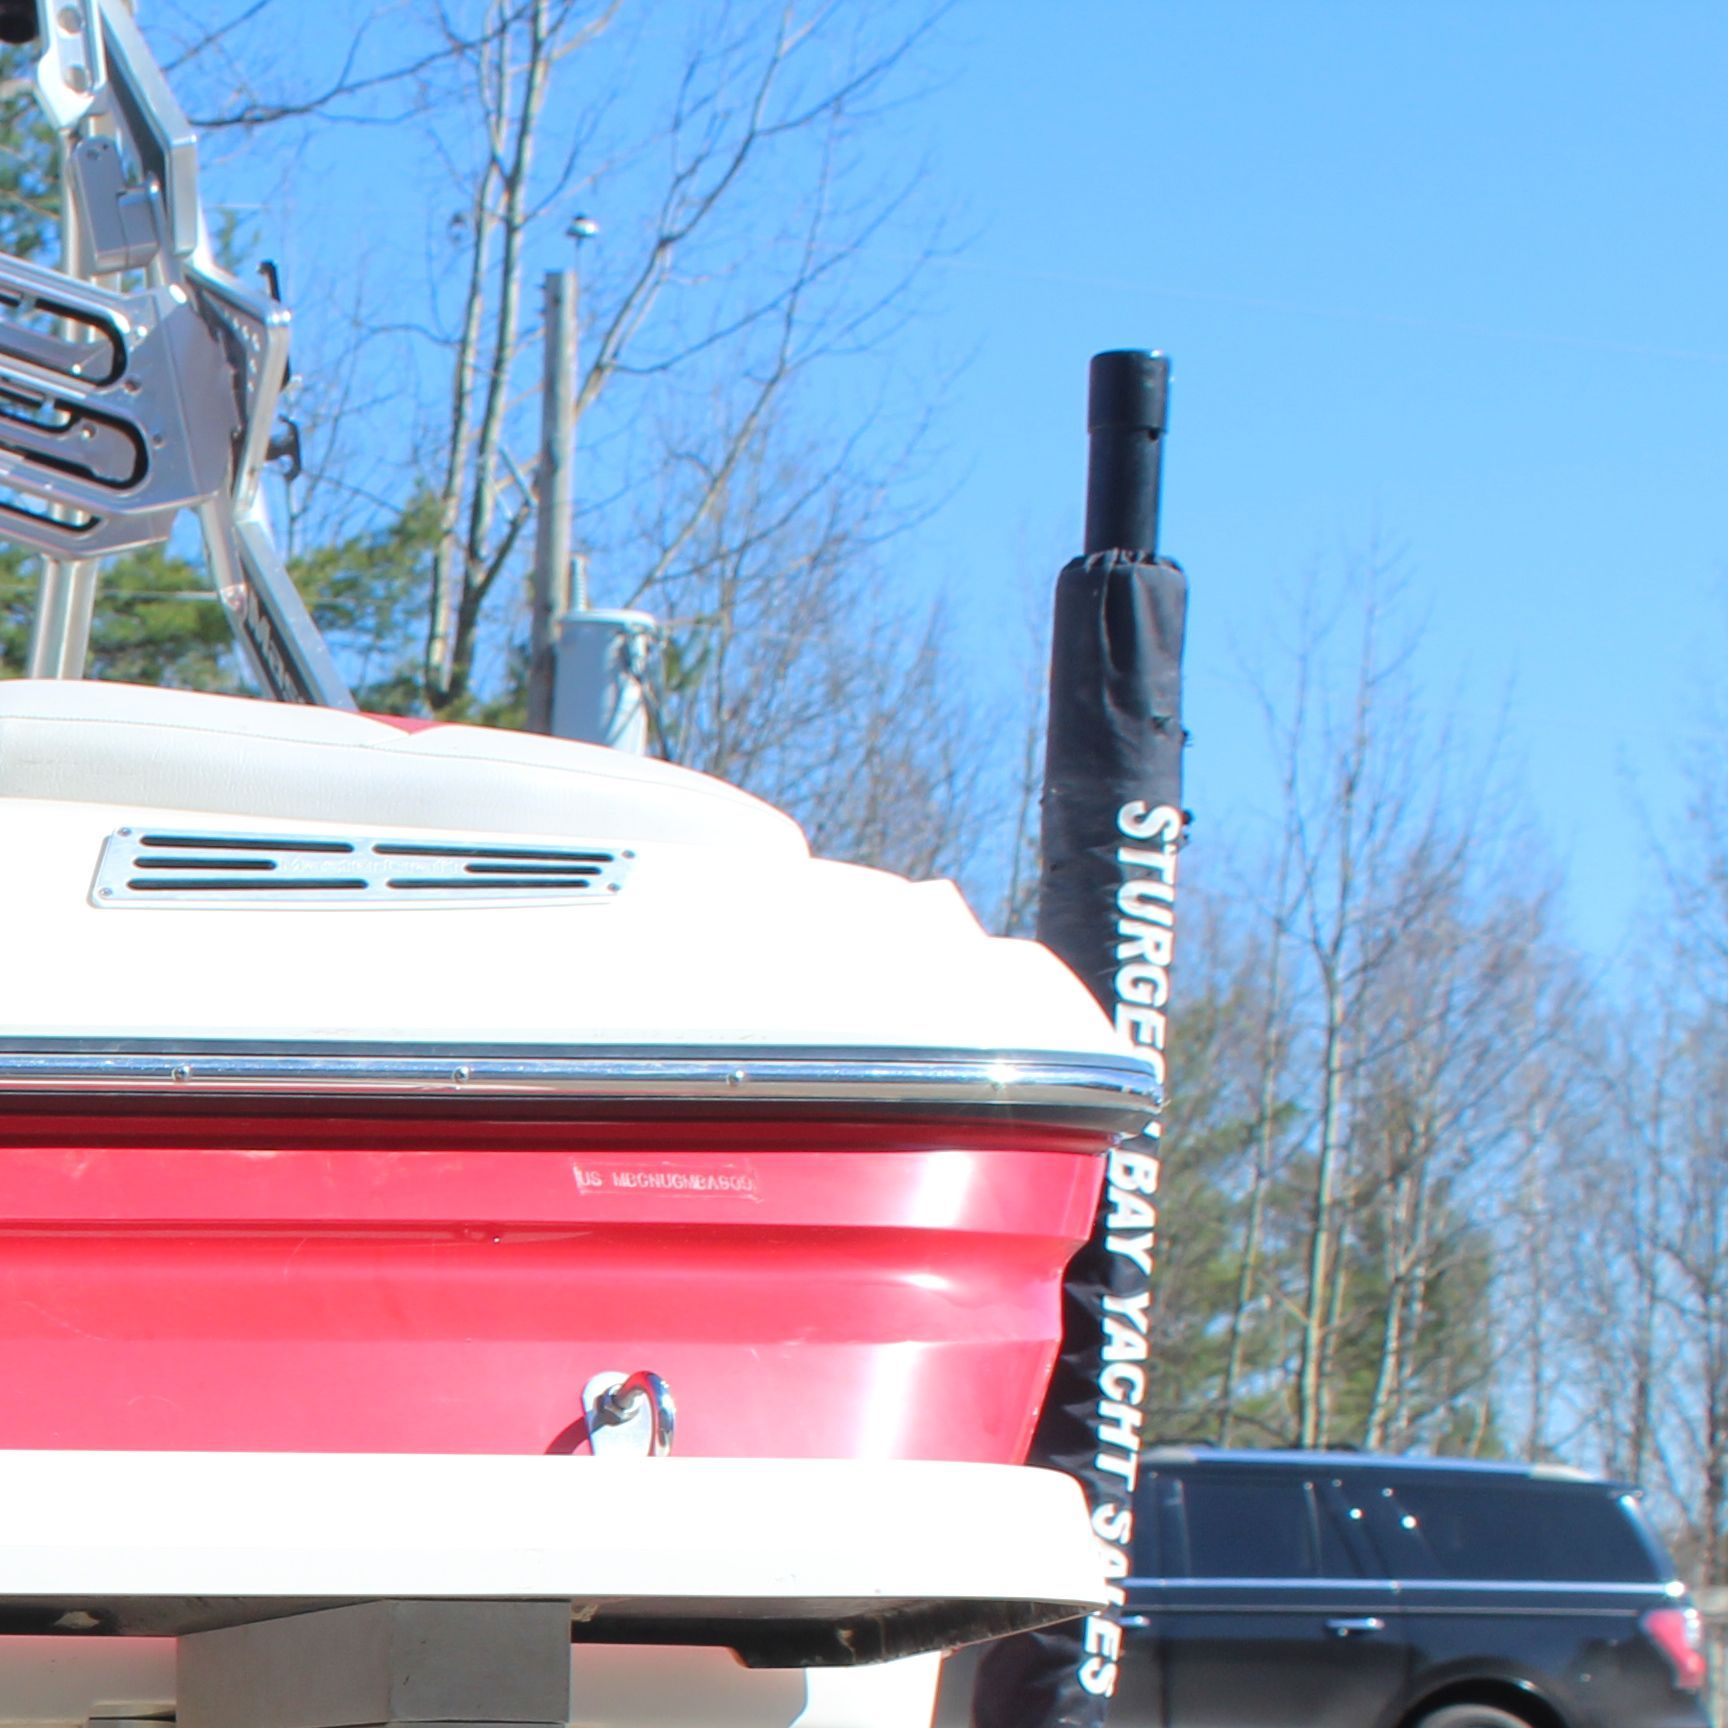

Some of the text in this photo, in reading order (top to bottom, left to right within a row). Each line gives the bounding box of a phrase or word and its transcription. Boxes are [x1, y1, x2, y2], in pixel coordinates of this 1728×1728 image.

[1114, 800, 1182, 1140] STURGE
[1106, 1149, 1161, 1276] BAY
[1095, 1292, 1151, 1493] YACHT
